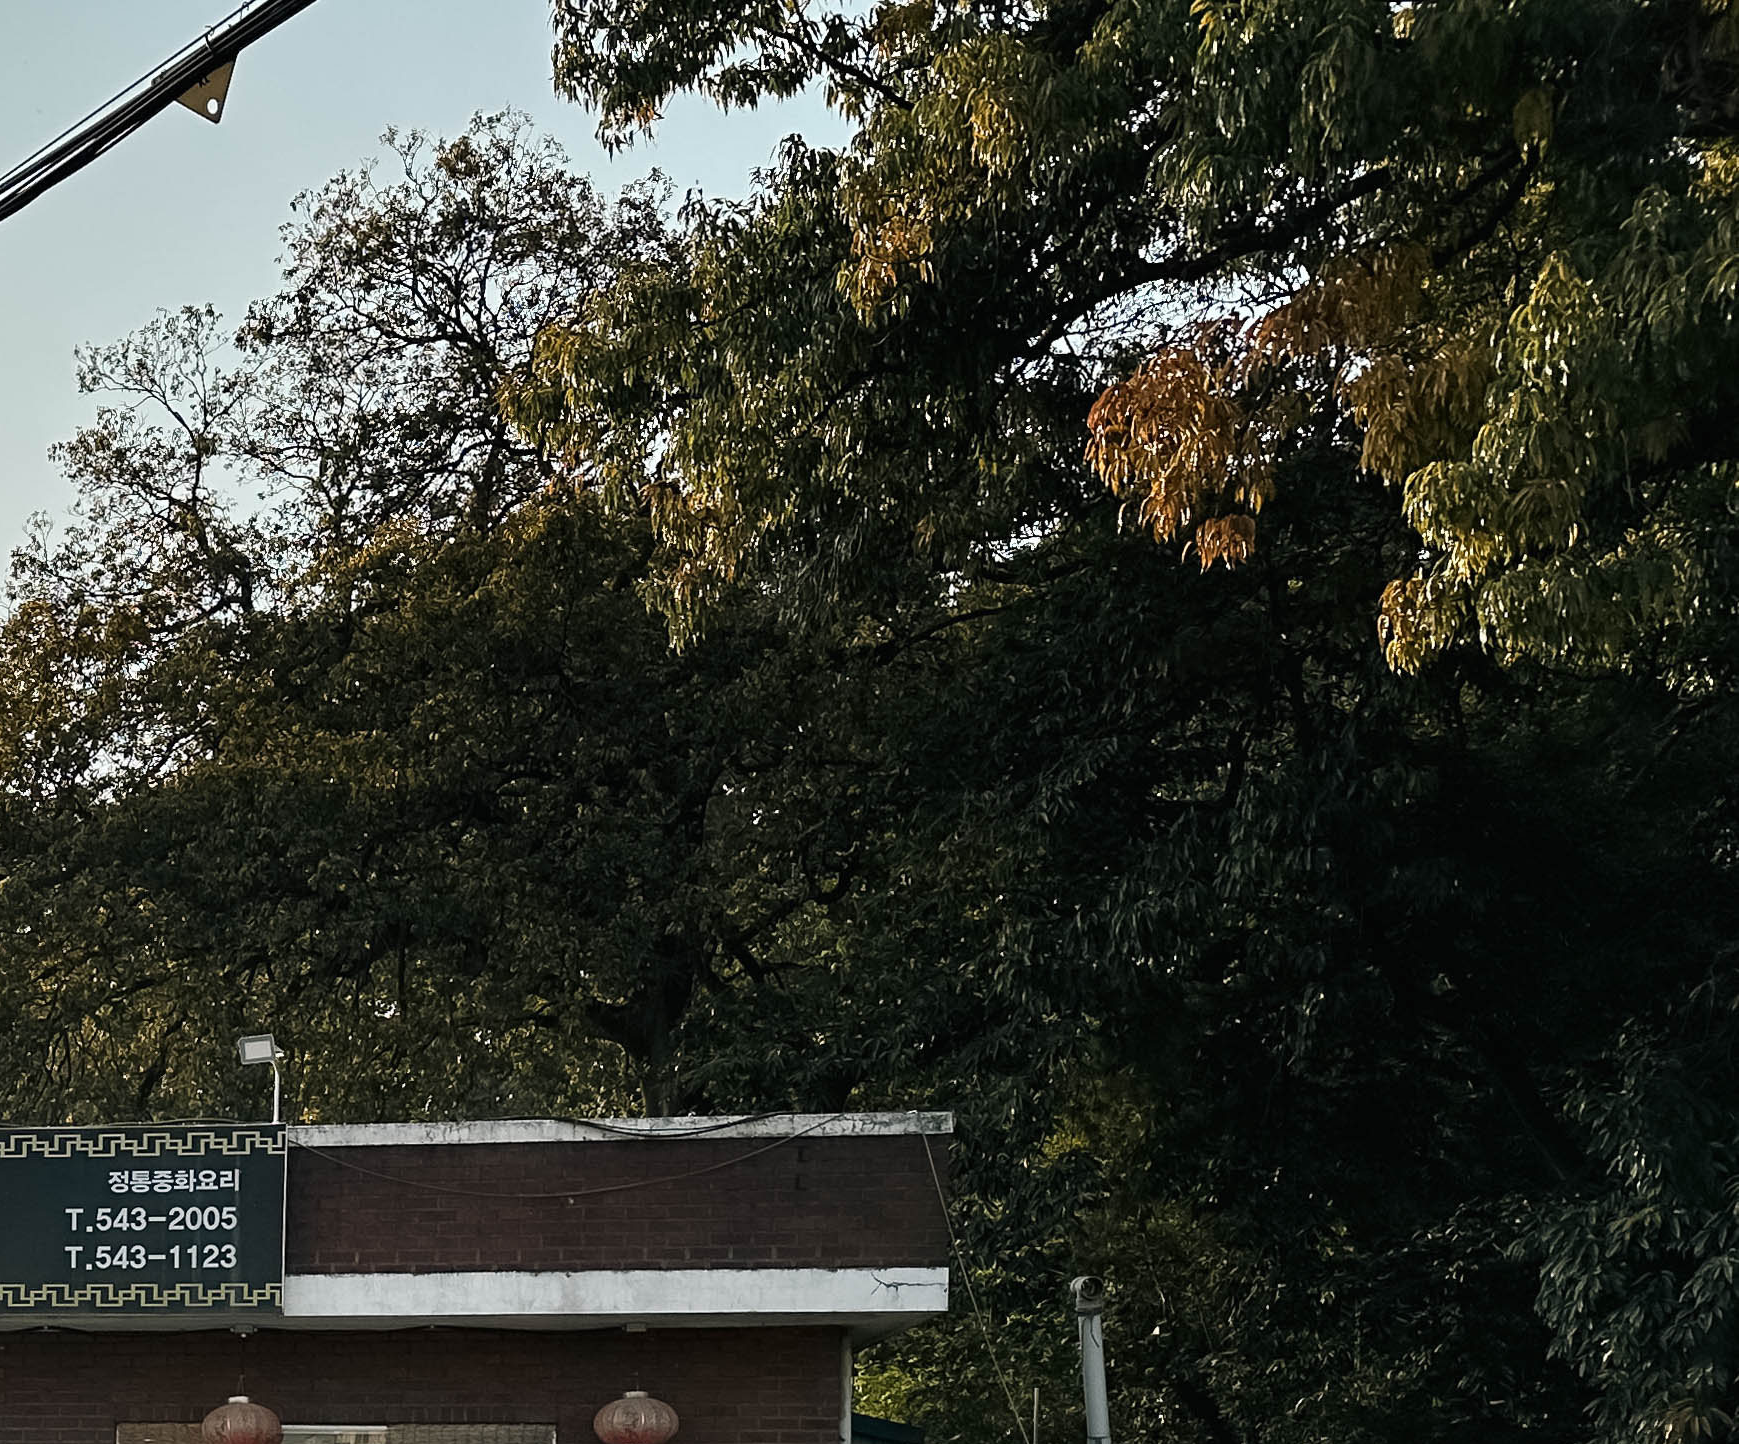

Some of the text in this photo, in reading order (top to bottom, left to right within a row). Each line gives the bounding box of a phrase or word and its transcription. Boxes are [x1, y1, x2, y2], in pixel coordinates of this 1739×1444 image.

[107, 1168, 241, 1194] 정통중화요리
[65, 1206, 238, 1233] T.543-2005
[65, 1244, 238, 1271] T.543-1123
